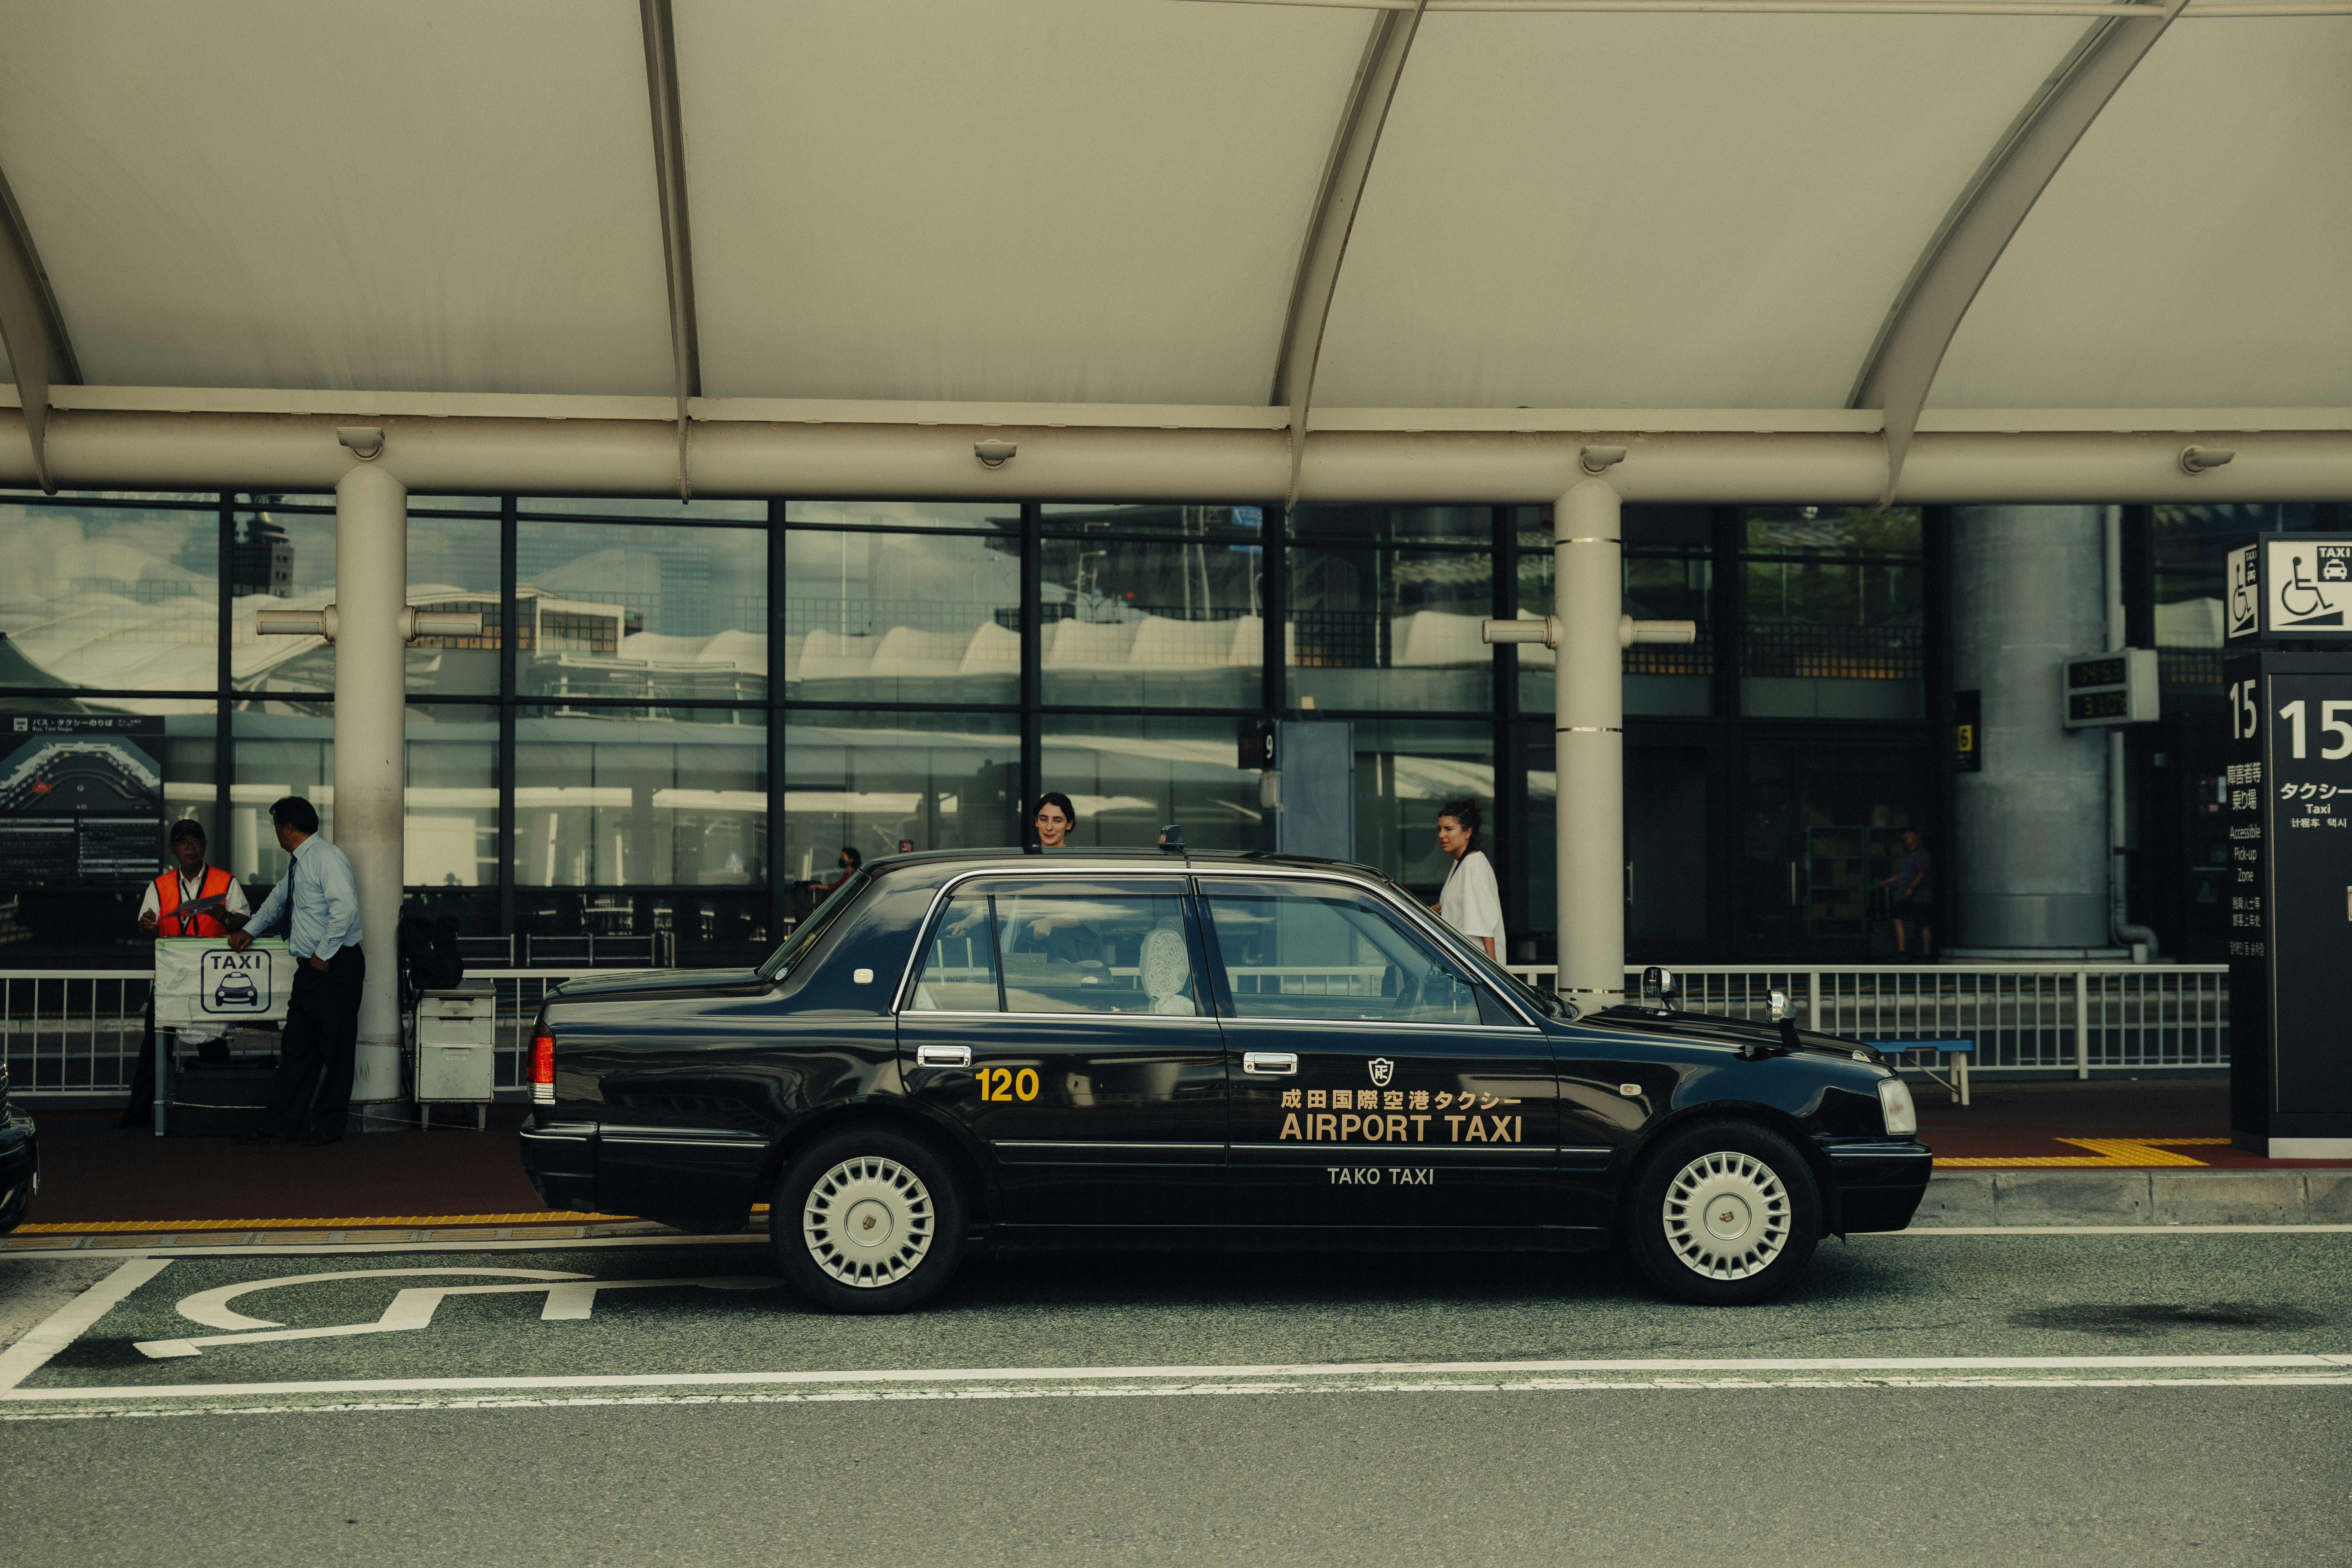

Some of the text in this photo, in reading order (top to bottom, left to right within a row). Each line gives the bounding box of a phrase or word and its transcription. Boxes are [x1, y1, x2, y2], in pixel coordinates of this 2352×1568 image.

[2245, 550, 2257, 560] TAXI
[2319, 547, 2350, 558] TAXI
[2229, 679, 2257, 740] 15
[2279, 700, 2352, 760] 15
[1266, 734, 1273, 759] 9
[2227, 761, 2262, 785] 障害者等
[2232, 788, 2257, 811] 乗り場
[2280, 782, 2352, 800] タクシー
[2305, 803, 2331, 814] Taxi
[2229, 823, 2261, 840] Accessible
[2290, 818, 2347, 828] 计程车 택시
[2234, 846, 2257, 863] Pick-up
[2237, 868, 2254, 882] Zone
[210, 954, 260, 970] TAXI
[975, 1068, 1039, 1102] 120
[1280, 1089, 1522, 1110] 成田国際空港タクシー
[1279, 1113, 1522, 1142] AIRPORT TAXI
[1327, 1168, 1434, 1185] TAKO TAXI
